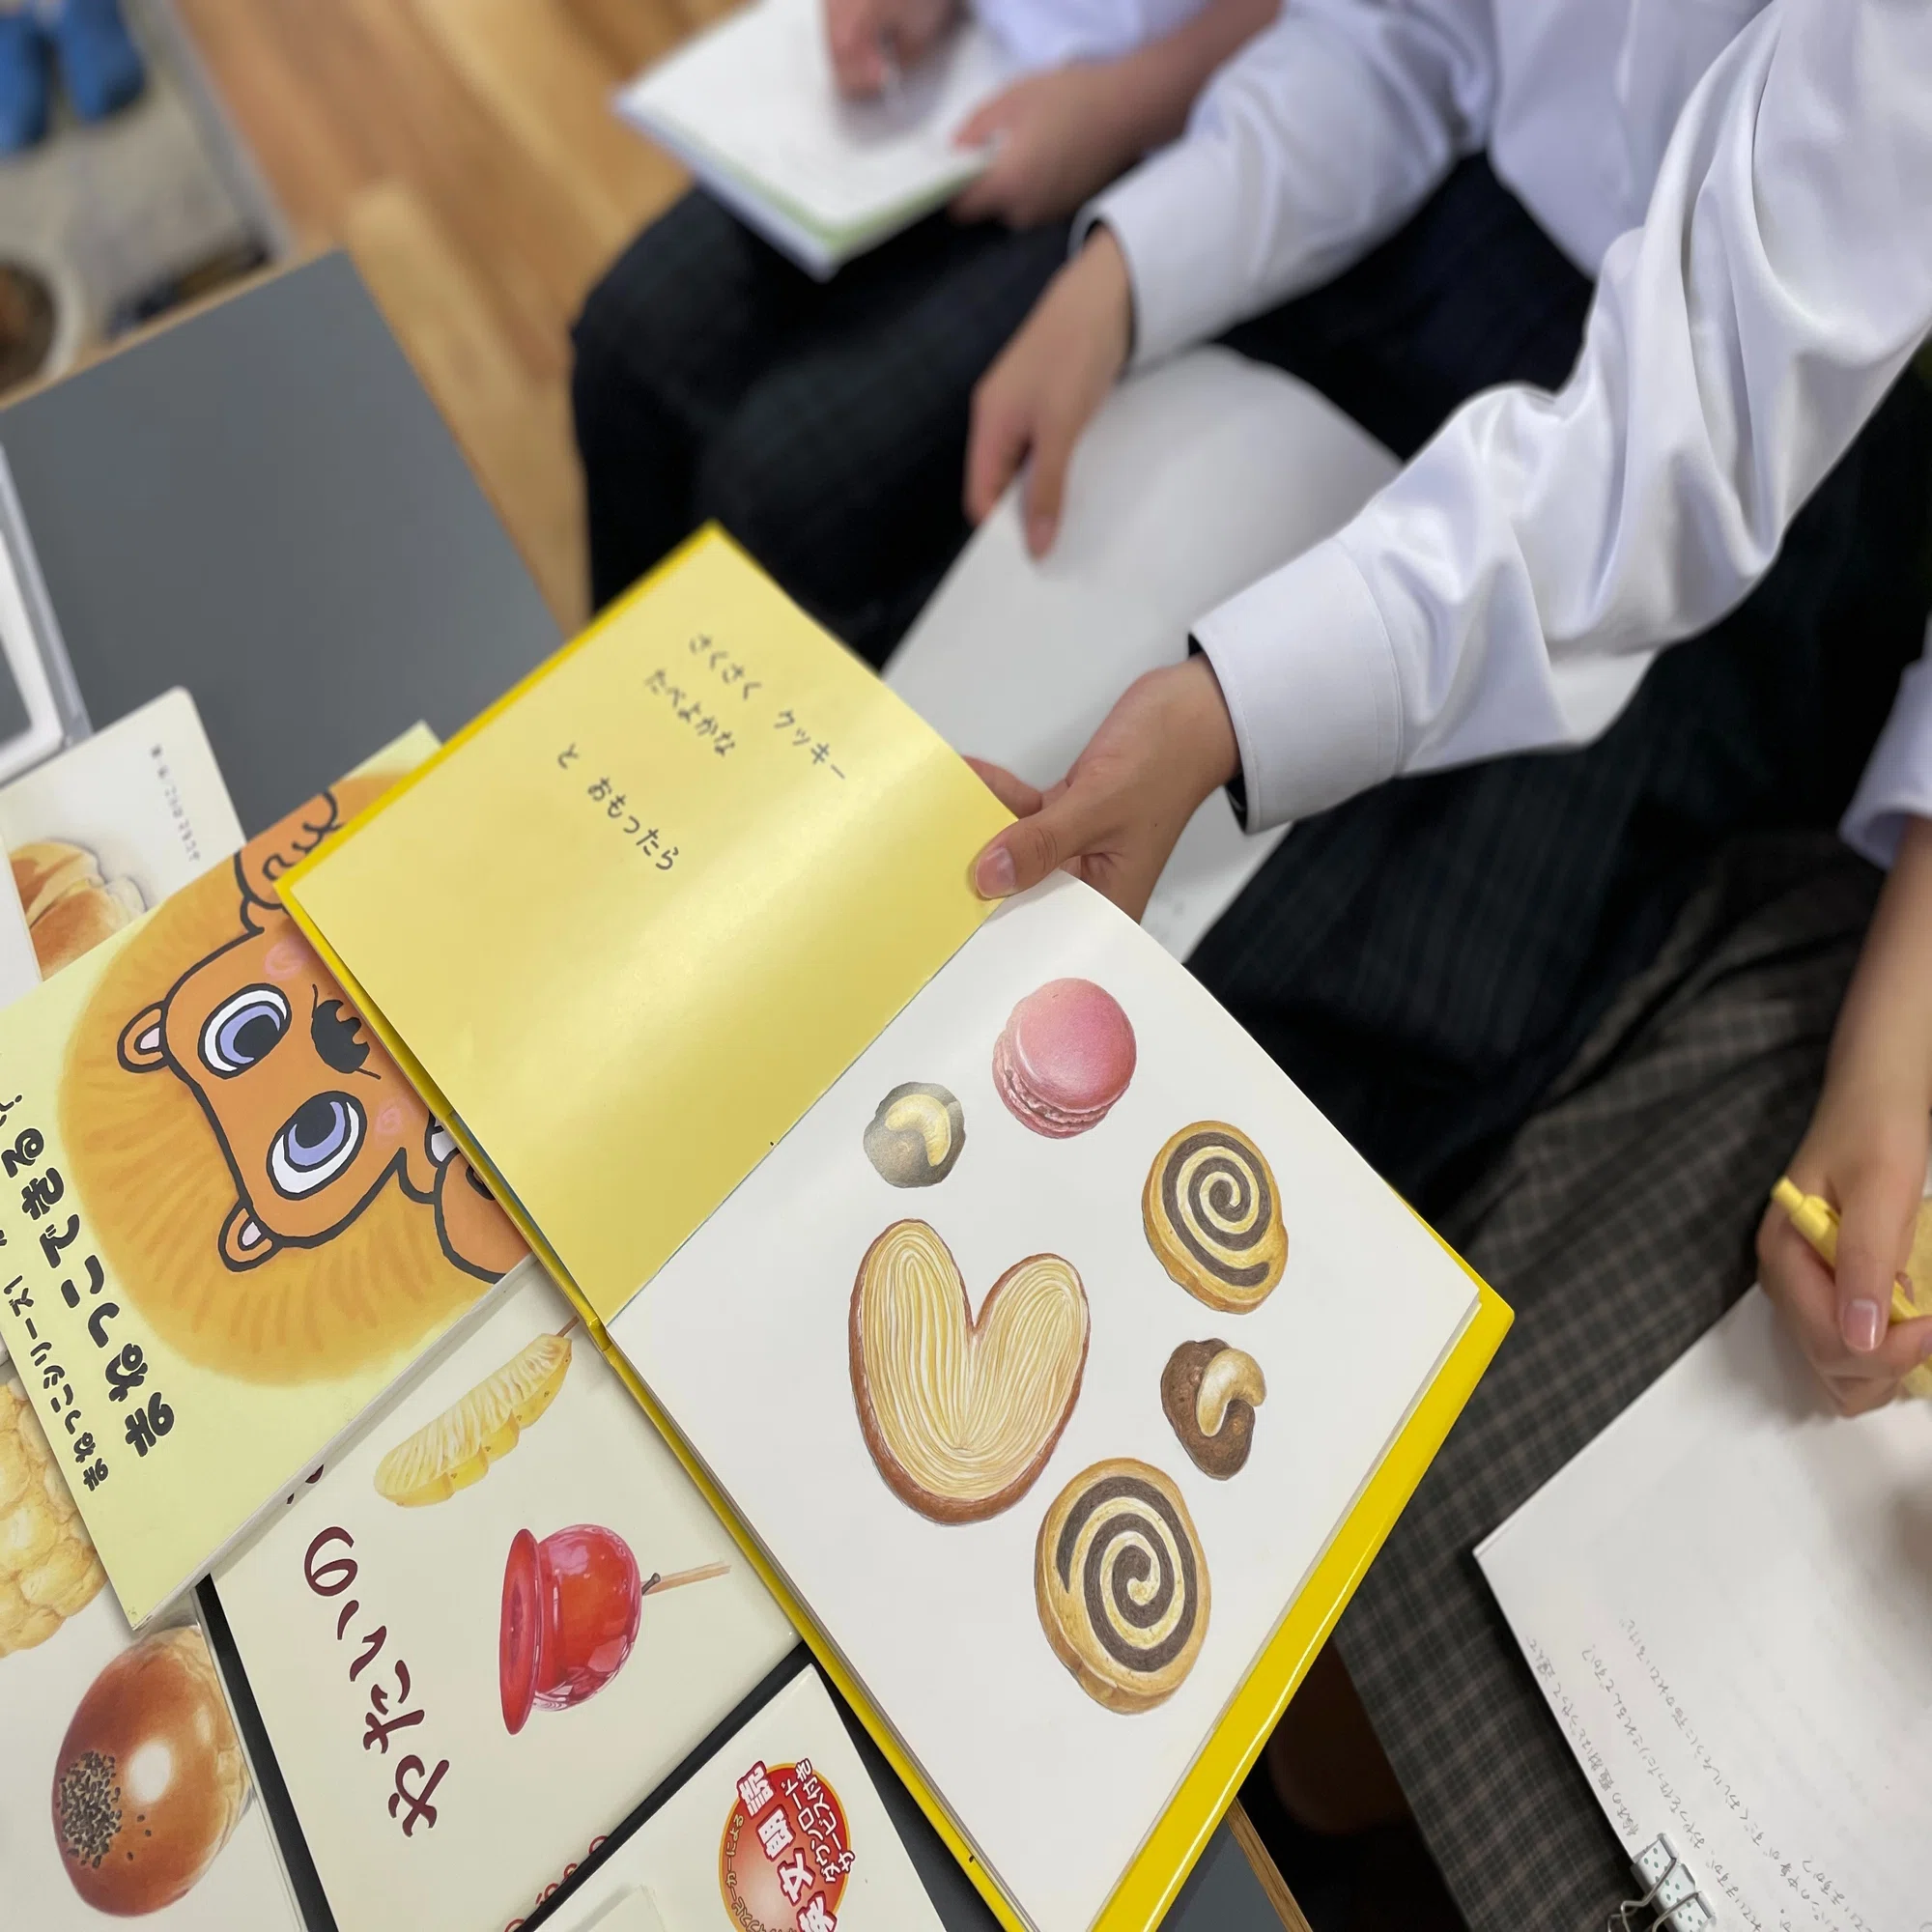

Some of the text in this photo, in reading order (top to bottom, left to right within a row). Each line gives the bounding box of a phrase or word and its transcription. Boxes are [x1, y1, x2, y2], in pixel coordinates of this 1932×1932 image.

[644, 668, 736, 755] たべよかな
[689, 634, 845, 779] さくさく クッキー
[556, 742, 679, 870] と おもったら
[287, 1464, 449, 1837] やたいの
[781, 1778, 840, 1884] ダウンロード
[795, 1758, 855, 1872] サービス付き
